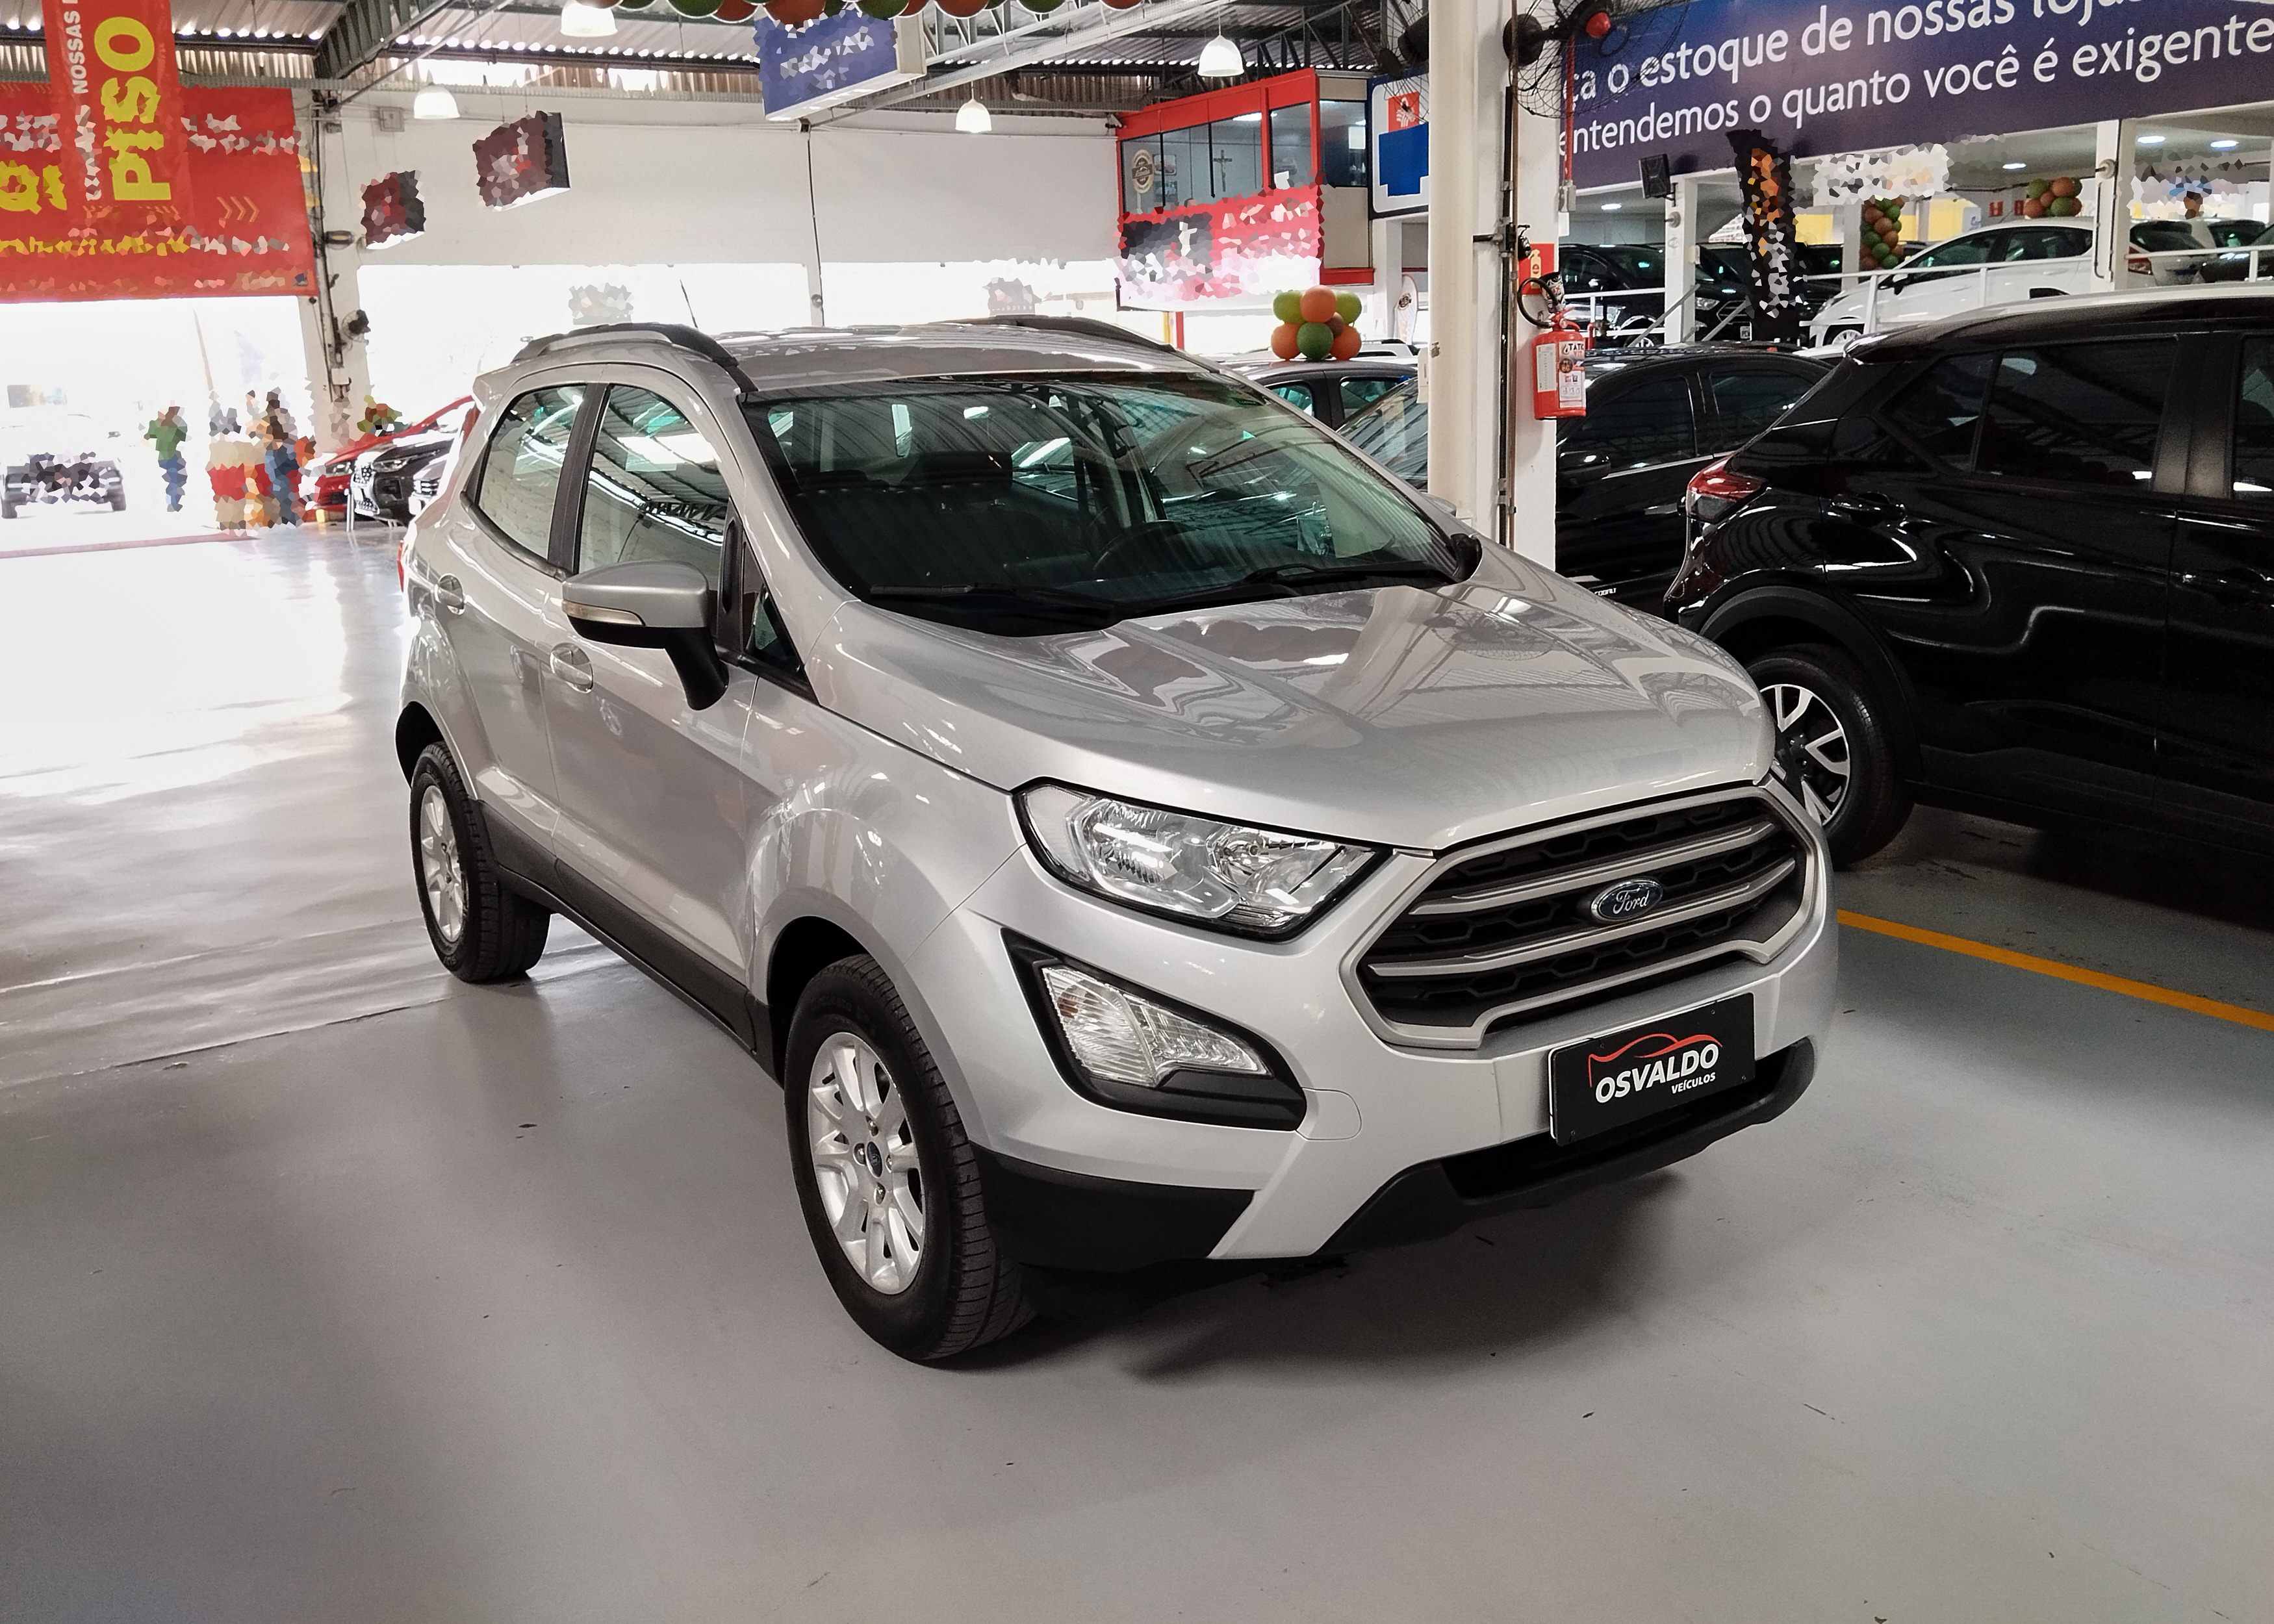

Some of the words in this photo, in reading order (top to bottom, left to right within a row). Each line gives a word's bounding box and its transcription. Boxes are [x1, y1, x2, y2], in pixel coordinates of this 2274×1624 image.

[64, 10, 88, 94] NOSSAS
[1608, 64, 1629, 94] o
[1641, 29, 1789, 87] estoque
[1801, 5, 1853, 56] de
[1867, 0, 2015, 45] nossas
[1750, 95, 1772, 123] o
[1782, 70, 1910, 129] quanto
[1923, 44, 2020, 98] você
[2034, 37, 2058, 82] é
[2072, 15, 2274, 82] exigente
[94, 16, 172, 201] PISO
[1613, 886, 1650, 914] Ford
[1595, 1043, 1718, 1104] OSVALDO
[1671, 1072, 1716, 1095] VEÍCULOS
